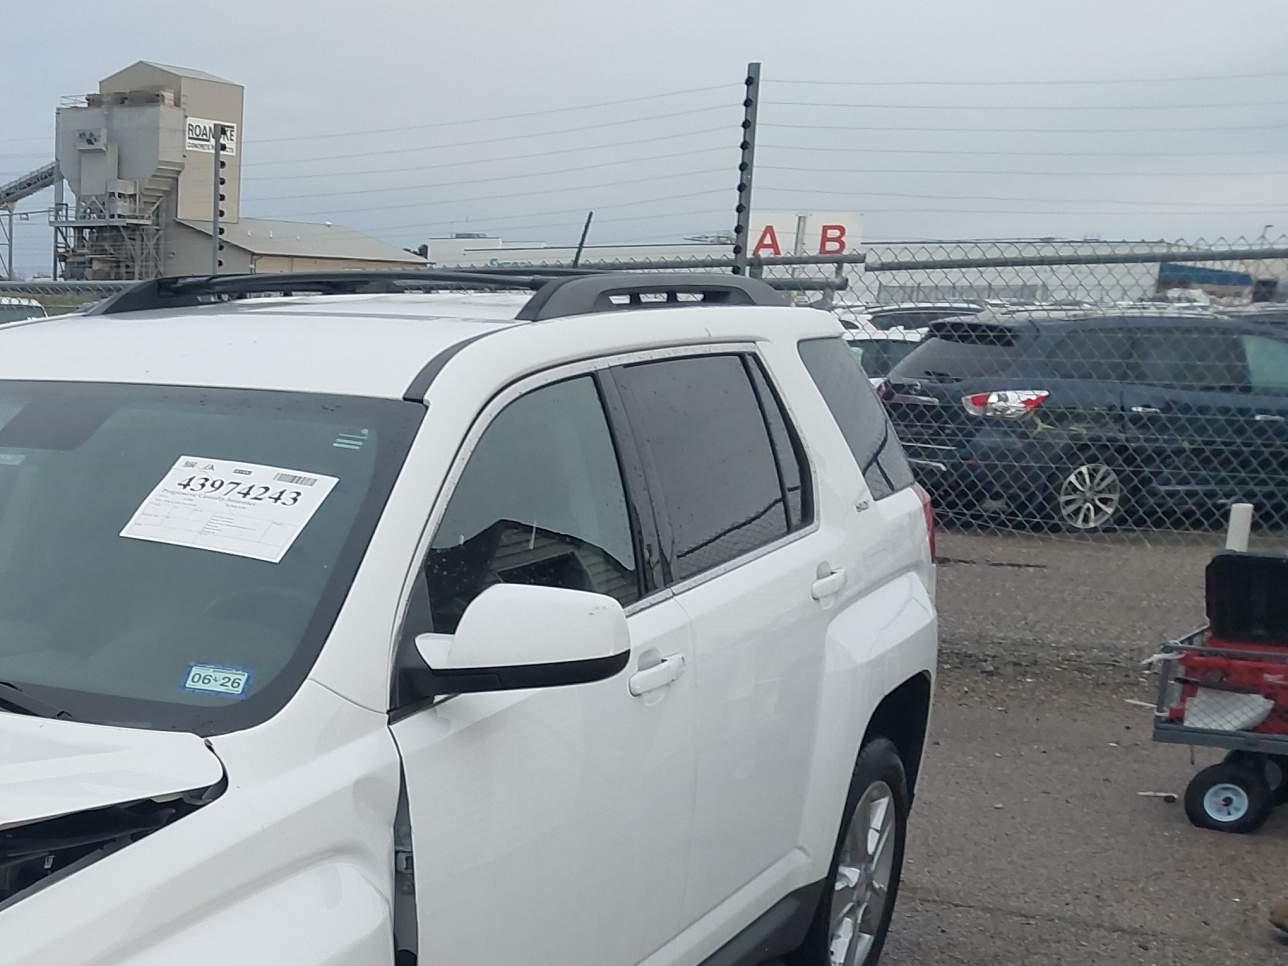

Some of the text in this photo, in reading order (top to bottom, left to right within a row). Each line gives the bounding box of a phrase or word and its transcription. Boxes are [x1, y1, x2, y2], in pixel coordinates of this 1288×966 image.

[187, 123, 235, 142] ROANKE
[752, 225, 781, 256] A
[819, 225, 846, 255] B
[178, 475, 302, 507] 43974243
[191, 672, 243, 689] 06 26
